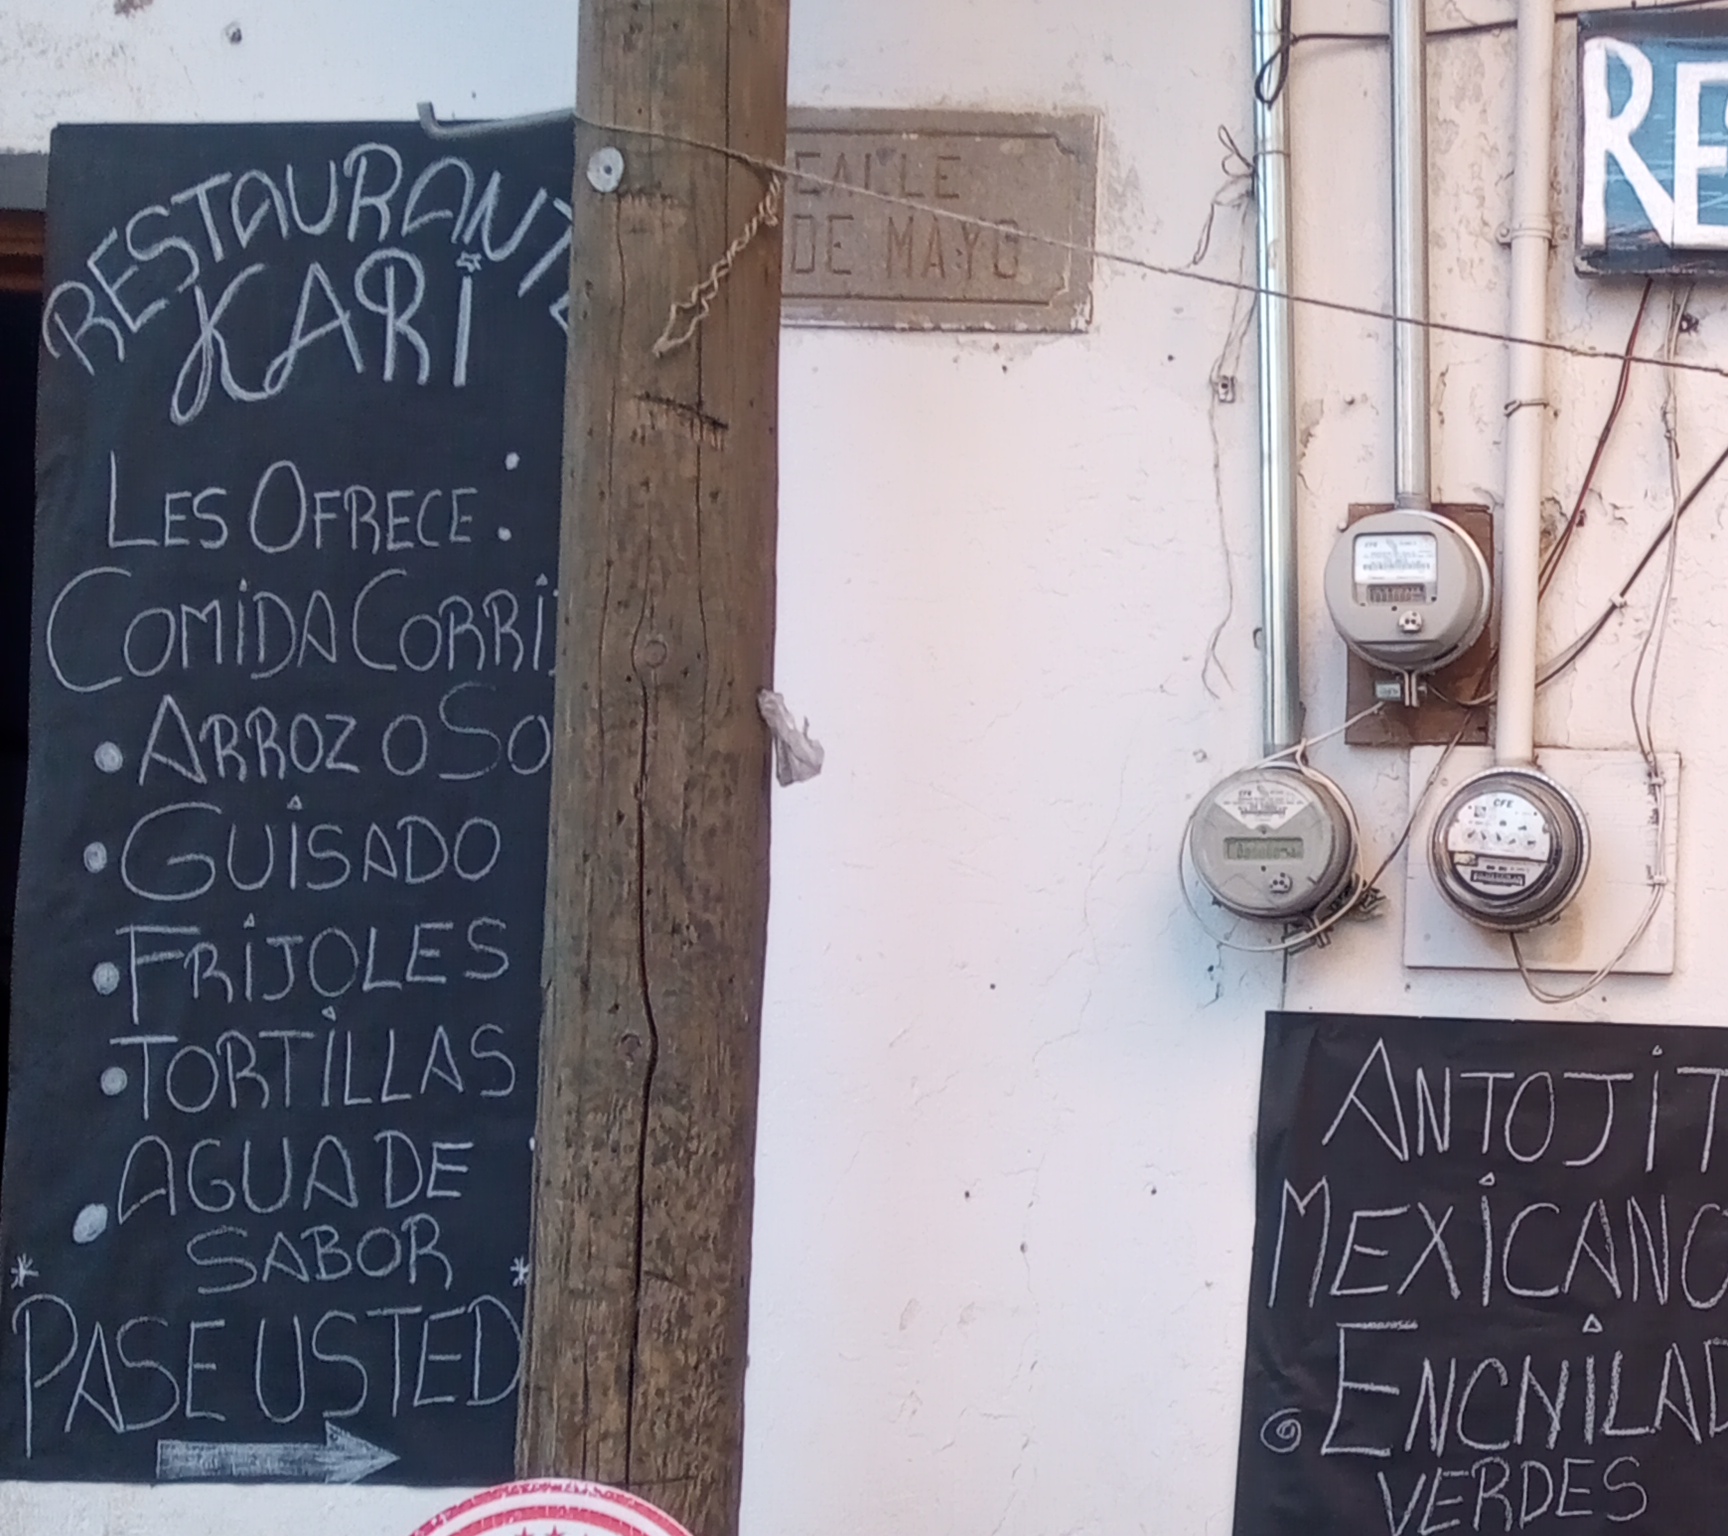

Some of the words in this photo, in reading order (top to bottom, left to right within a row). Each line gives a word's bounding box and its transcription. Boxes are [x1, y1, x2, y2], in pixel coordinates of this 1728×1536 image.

[42, 141, 572, 375] RESTAURANT
[885, 214, 1020, 280] MAYO
[107, 449, 229, 550] LES
[138, 694, 360, 785] ARROZ
[186, 1214, 454, 1294] SABOR
[11, 1293, 227, 1460] PASE
[254, 1294, 524, 1423] USTED
